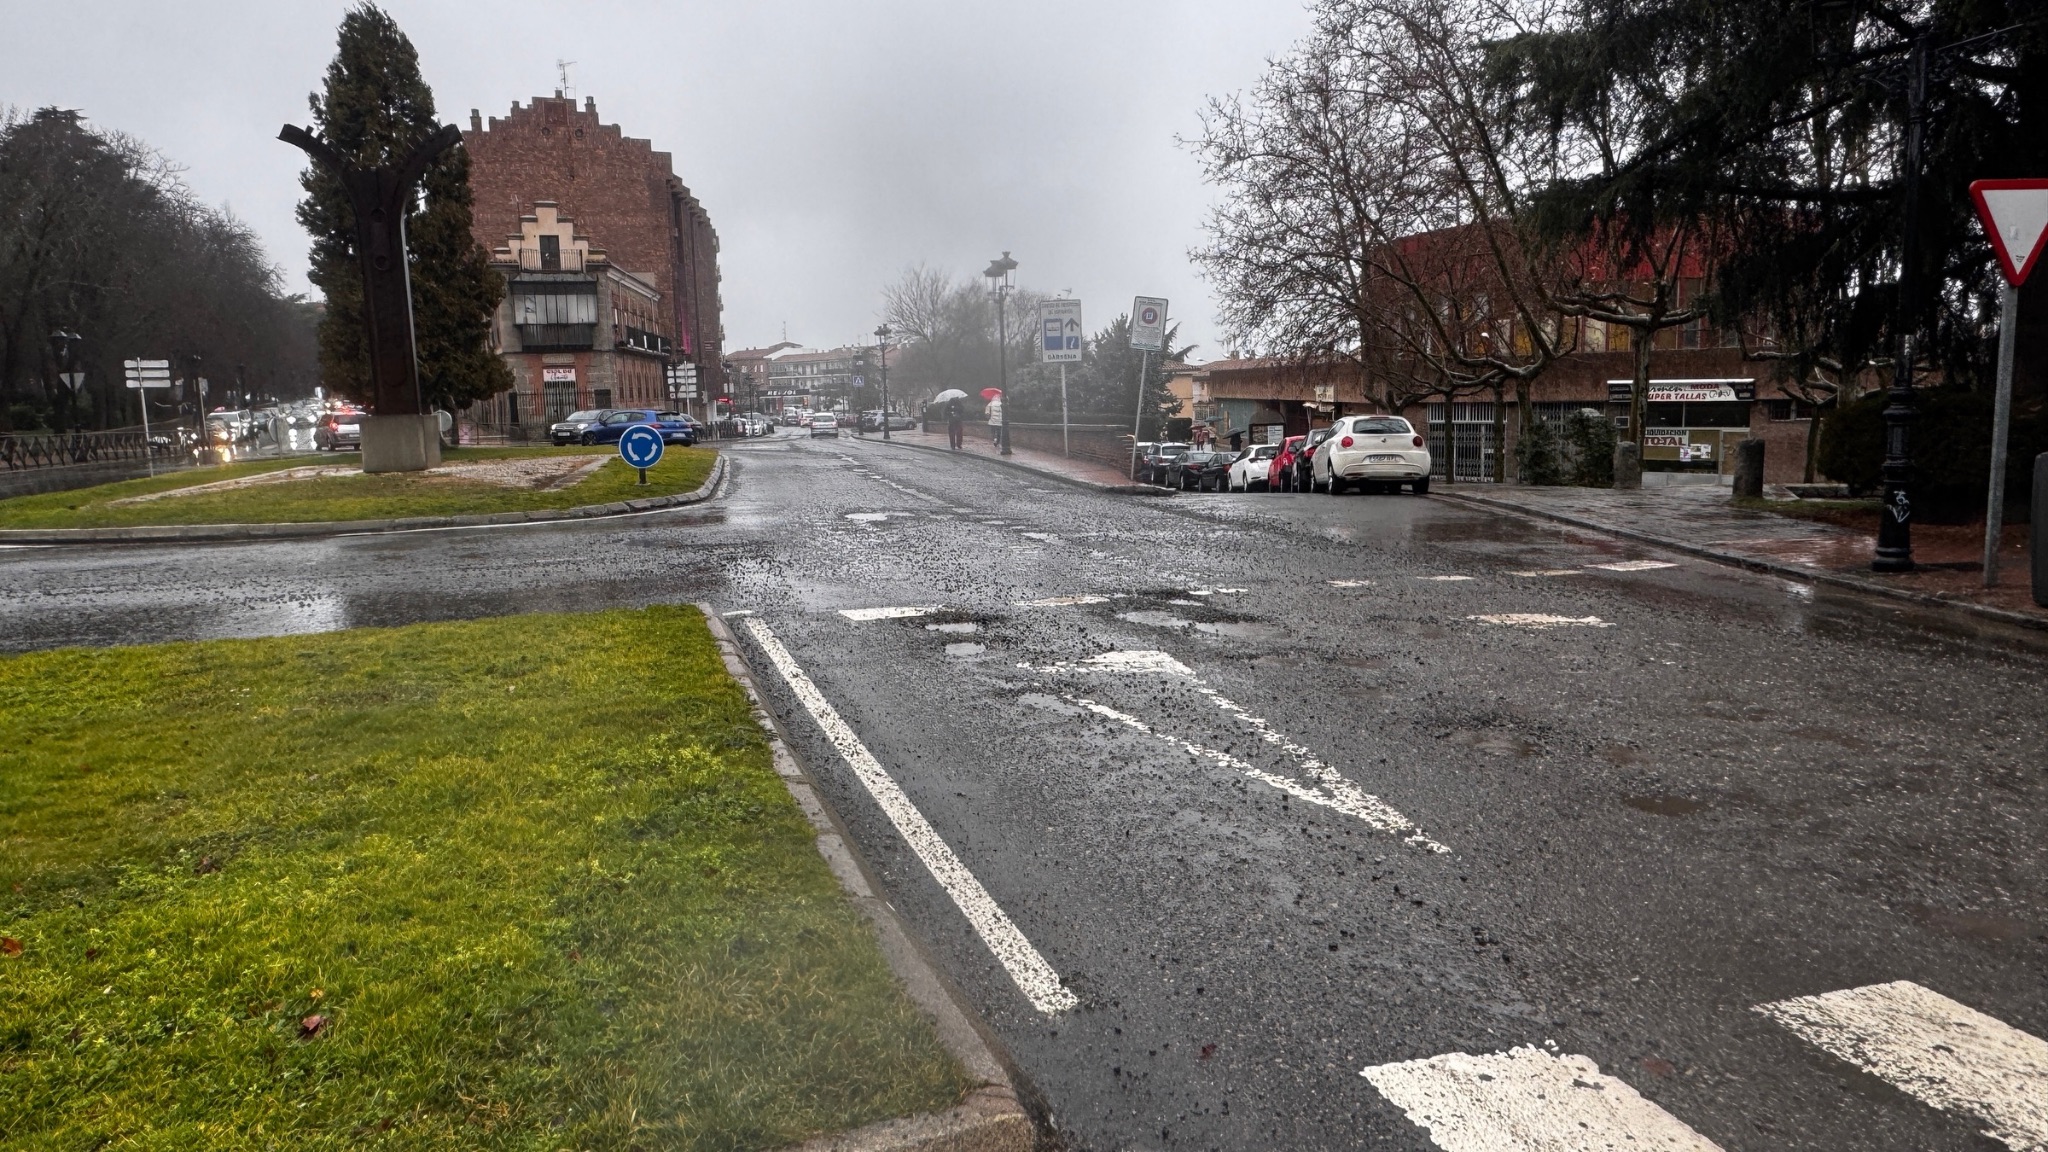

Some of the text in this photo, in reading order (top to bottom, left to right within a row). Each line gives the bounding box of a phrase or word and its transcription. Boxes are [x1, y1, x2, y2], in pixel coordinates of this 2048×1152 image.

[1647, 392, 1707, 400] UPER TALLAS
[1644, 436, 1687, 446] TOTAL
